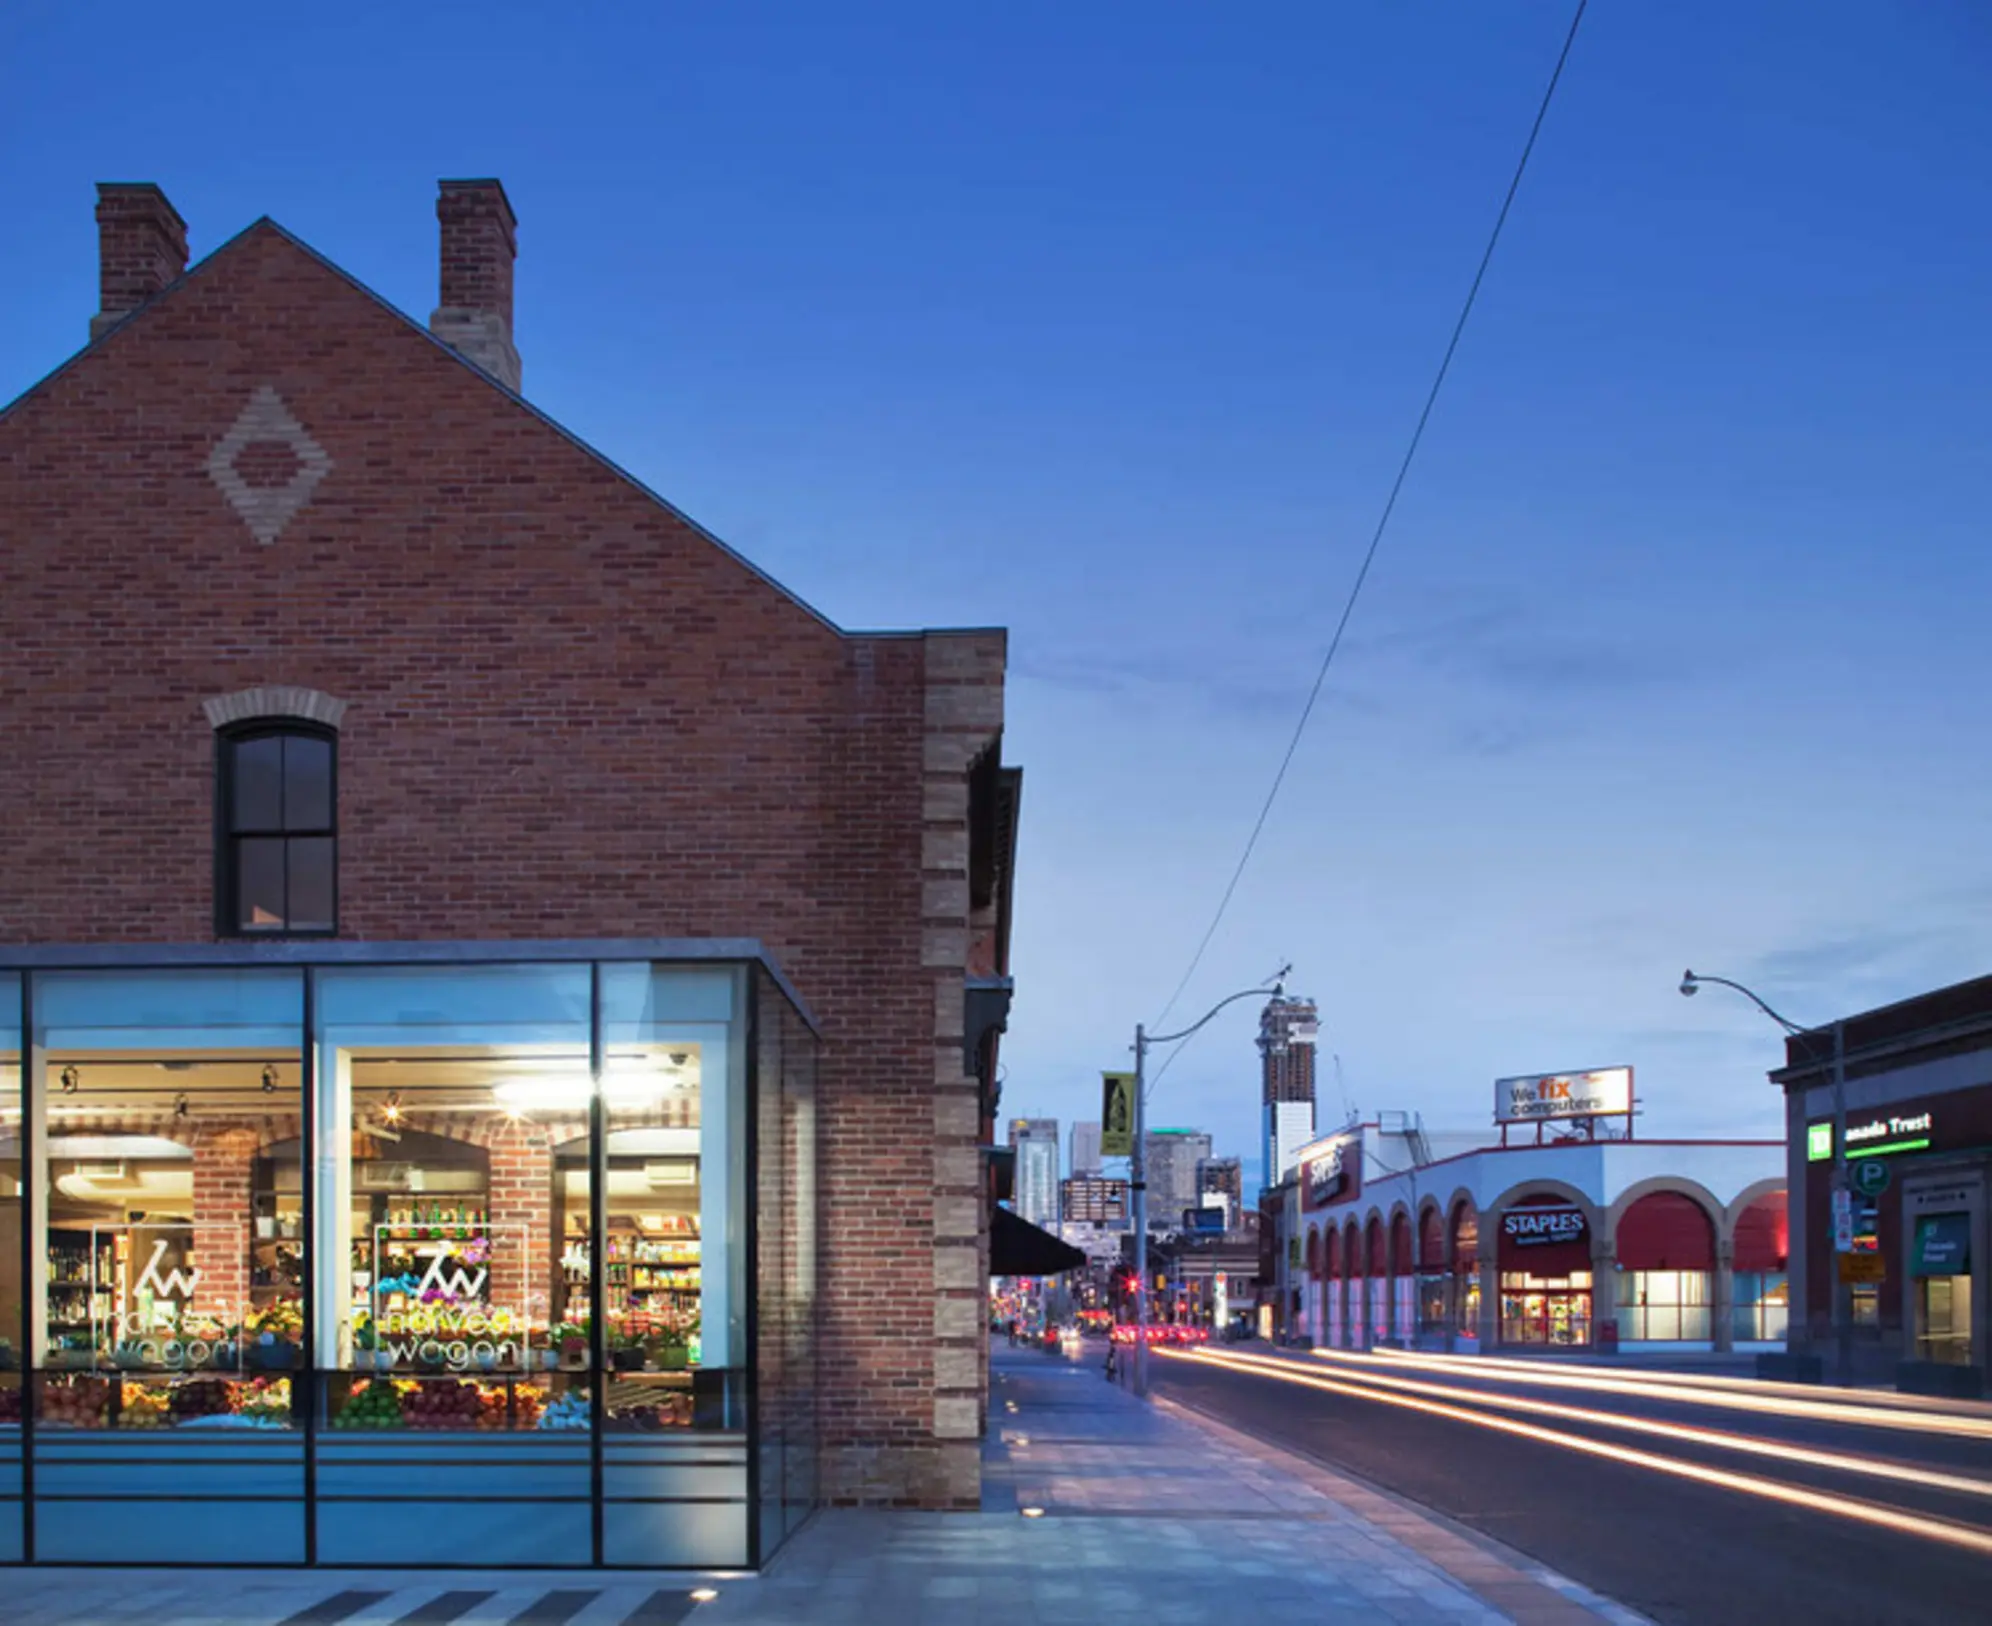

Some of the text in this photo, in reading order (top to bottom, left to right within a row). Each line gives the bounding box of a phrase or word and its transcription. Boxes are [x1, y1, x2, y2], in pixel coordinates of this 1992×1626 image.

[1511, 1078, 1570, 1102] We fix
[1510, 1097, 1604, 1117] computers
[1844, 1120, 1888, 1142] anada
[1889, 1112, 1932, 1134] Trust
[1505, 1212, 1584, 1234] STAPLES
[387, 1338, 518, 1372] wagon
